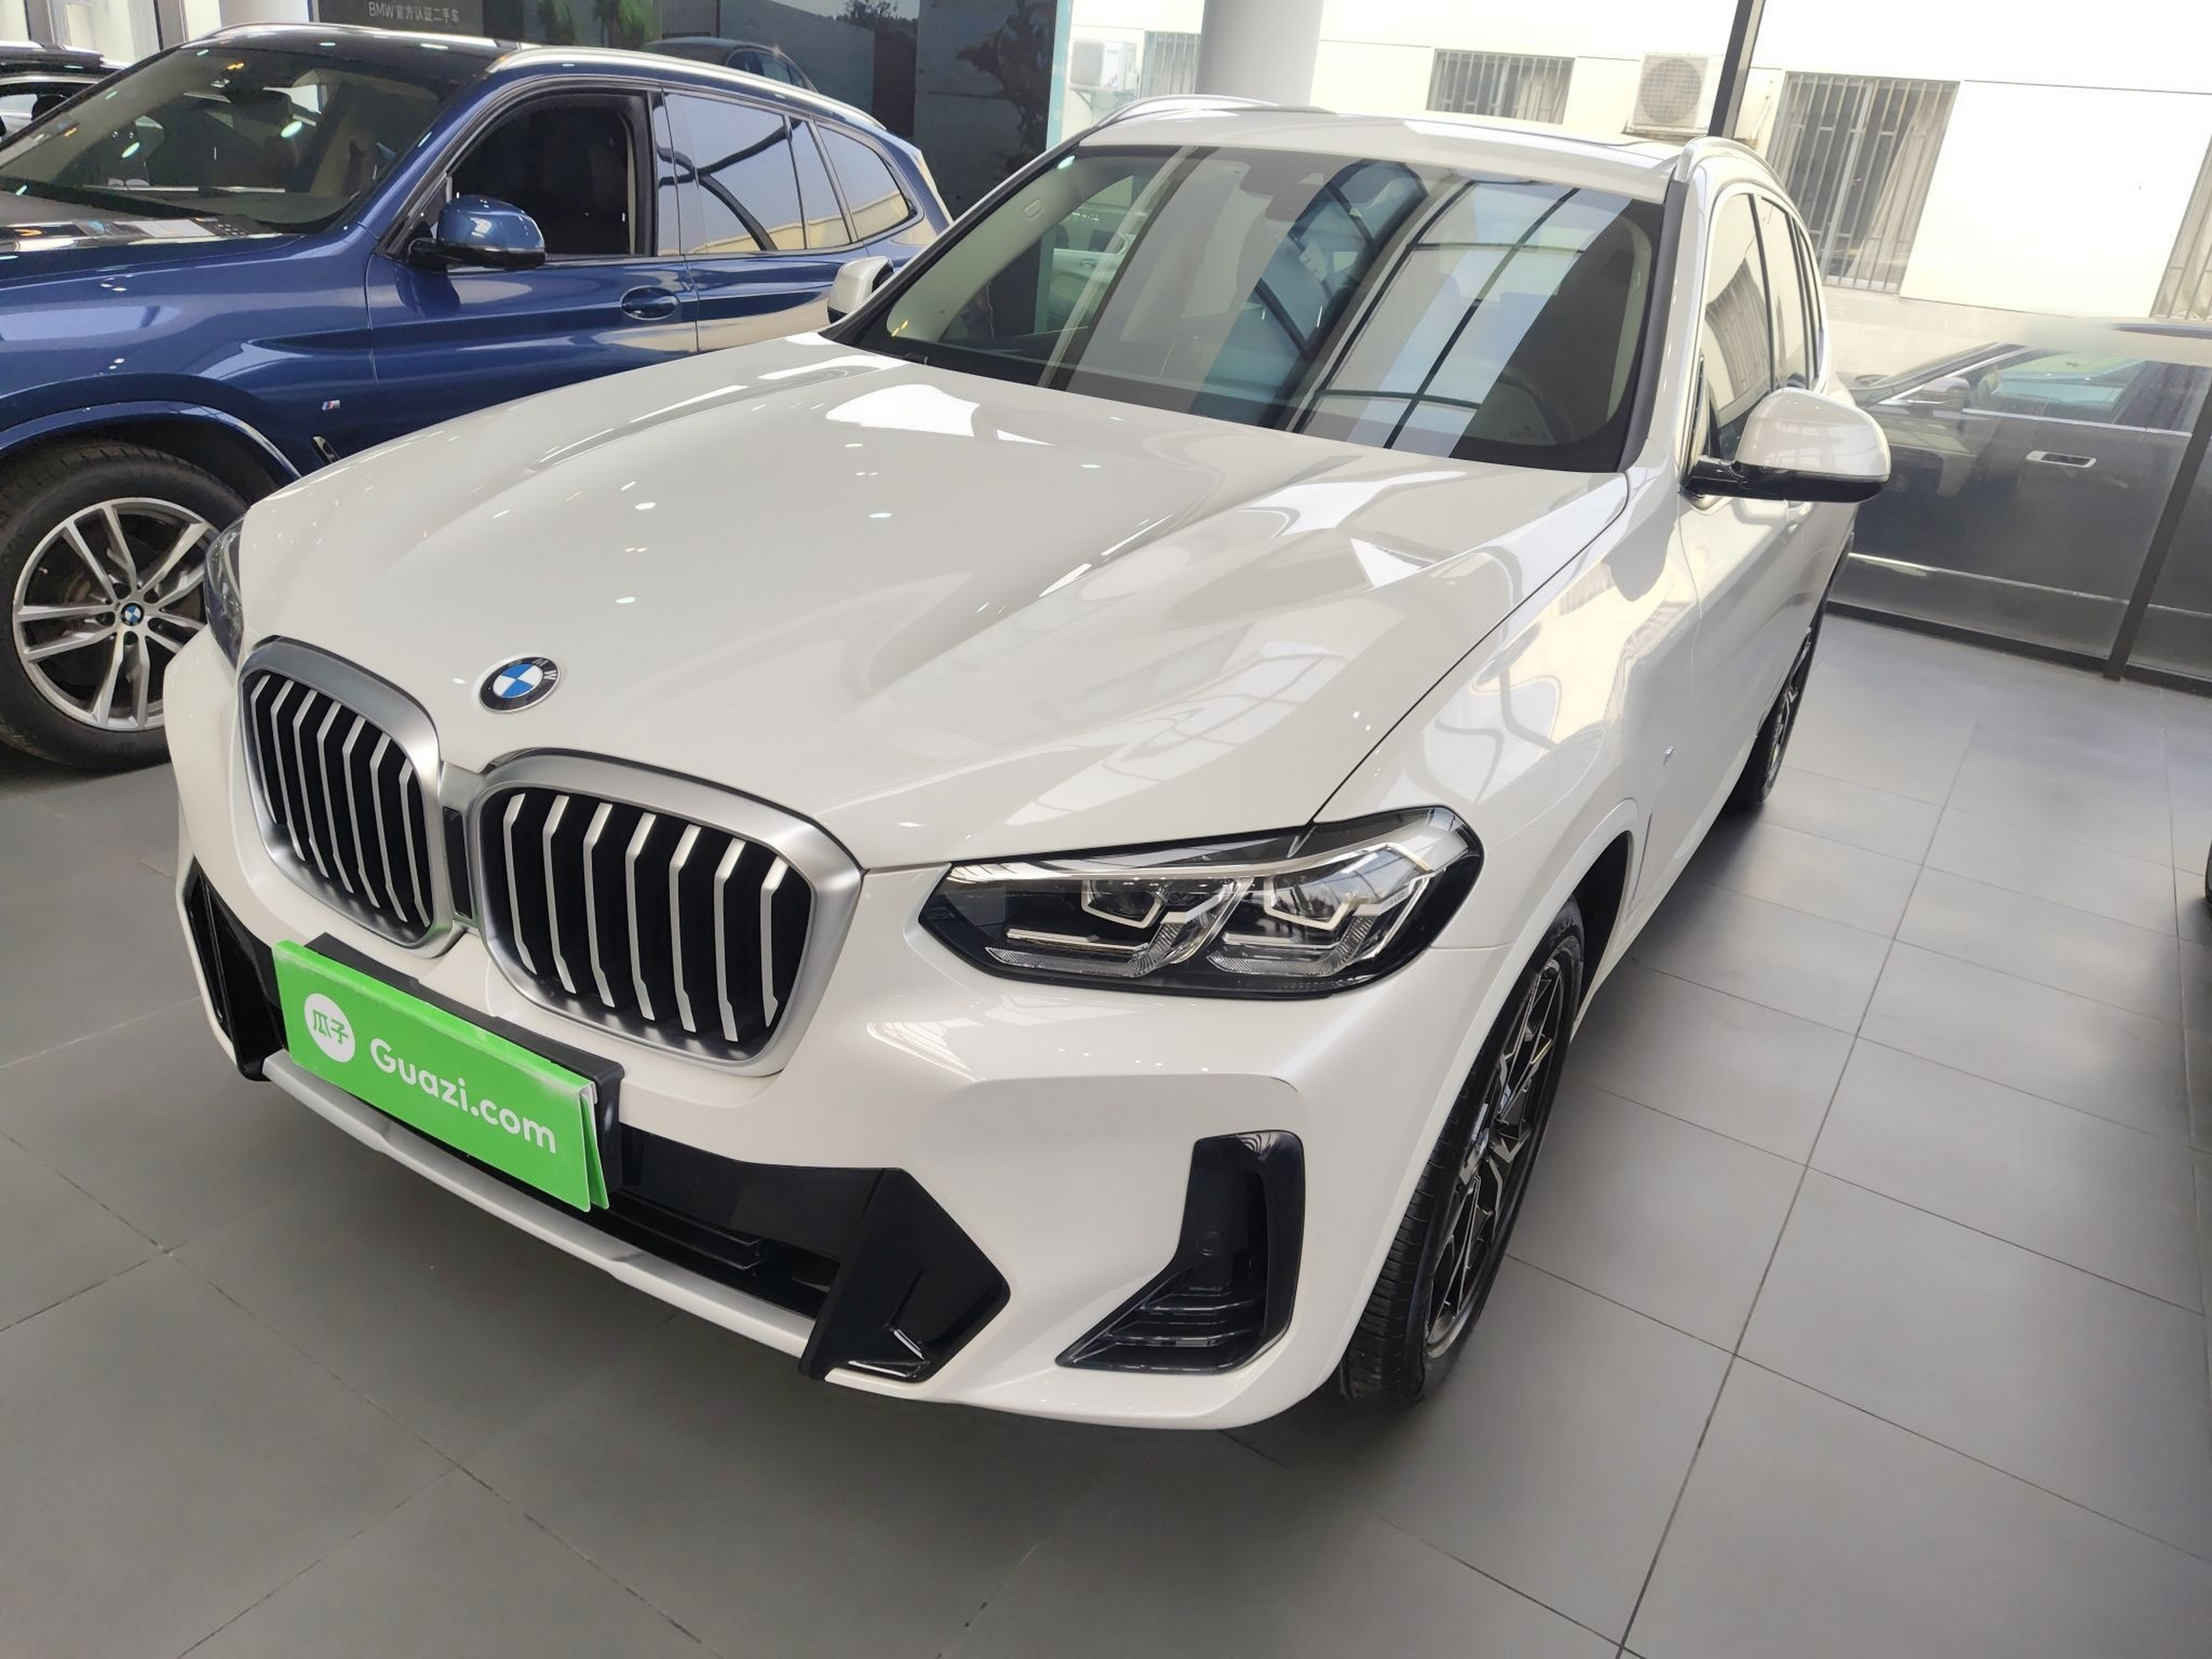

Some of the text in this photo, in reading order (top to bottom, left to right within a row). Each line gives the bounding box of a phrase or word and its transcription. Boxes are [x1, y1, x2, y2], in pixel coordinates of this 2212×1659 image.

[369, 2, 394, 18] BMW
[312, 1009, 556, 1154] 瓜子 Guazi.com
